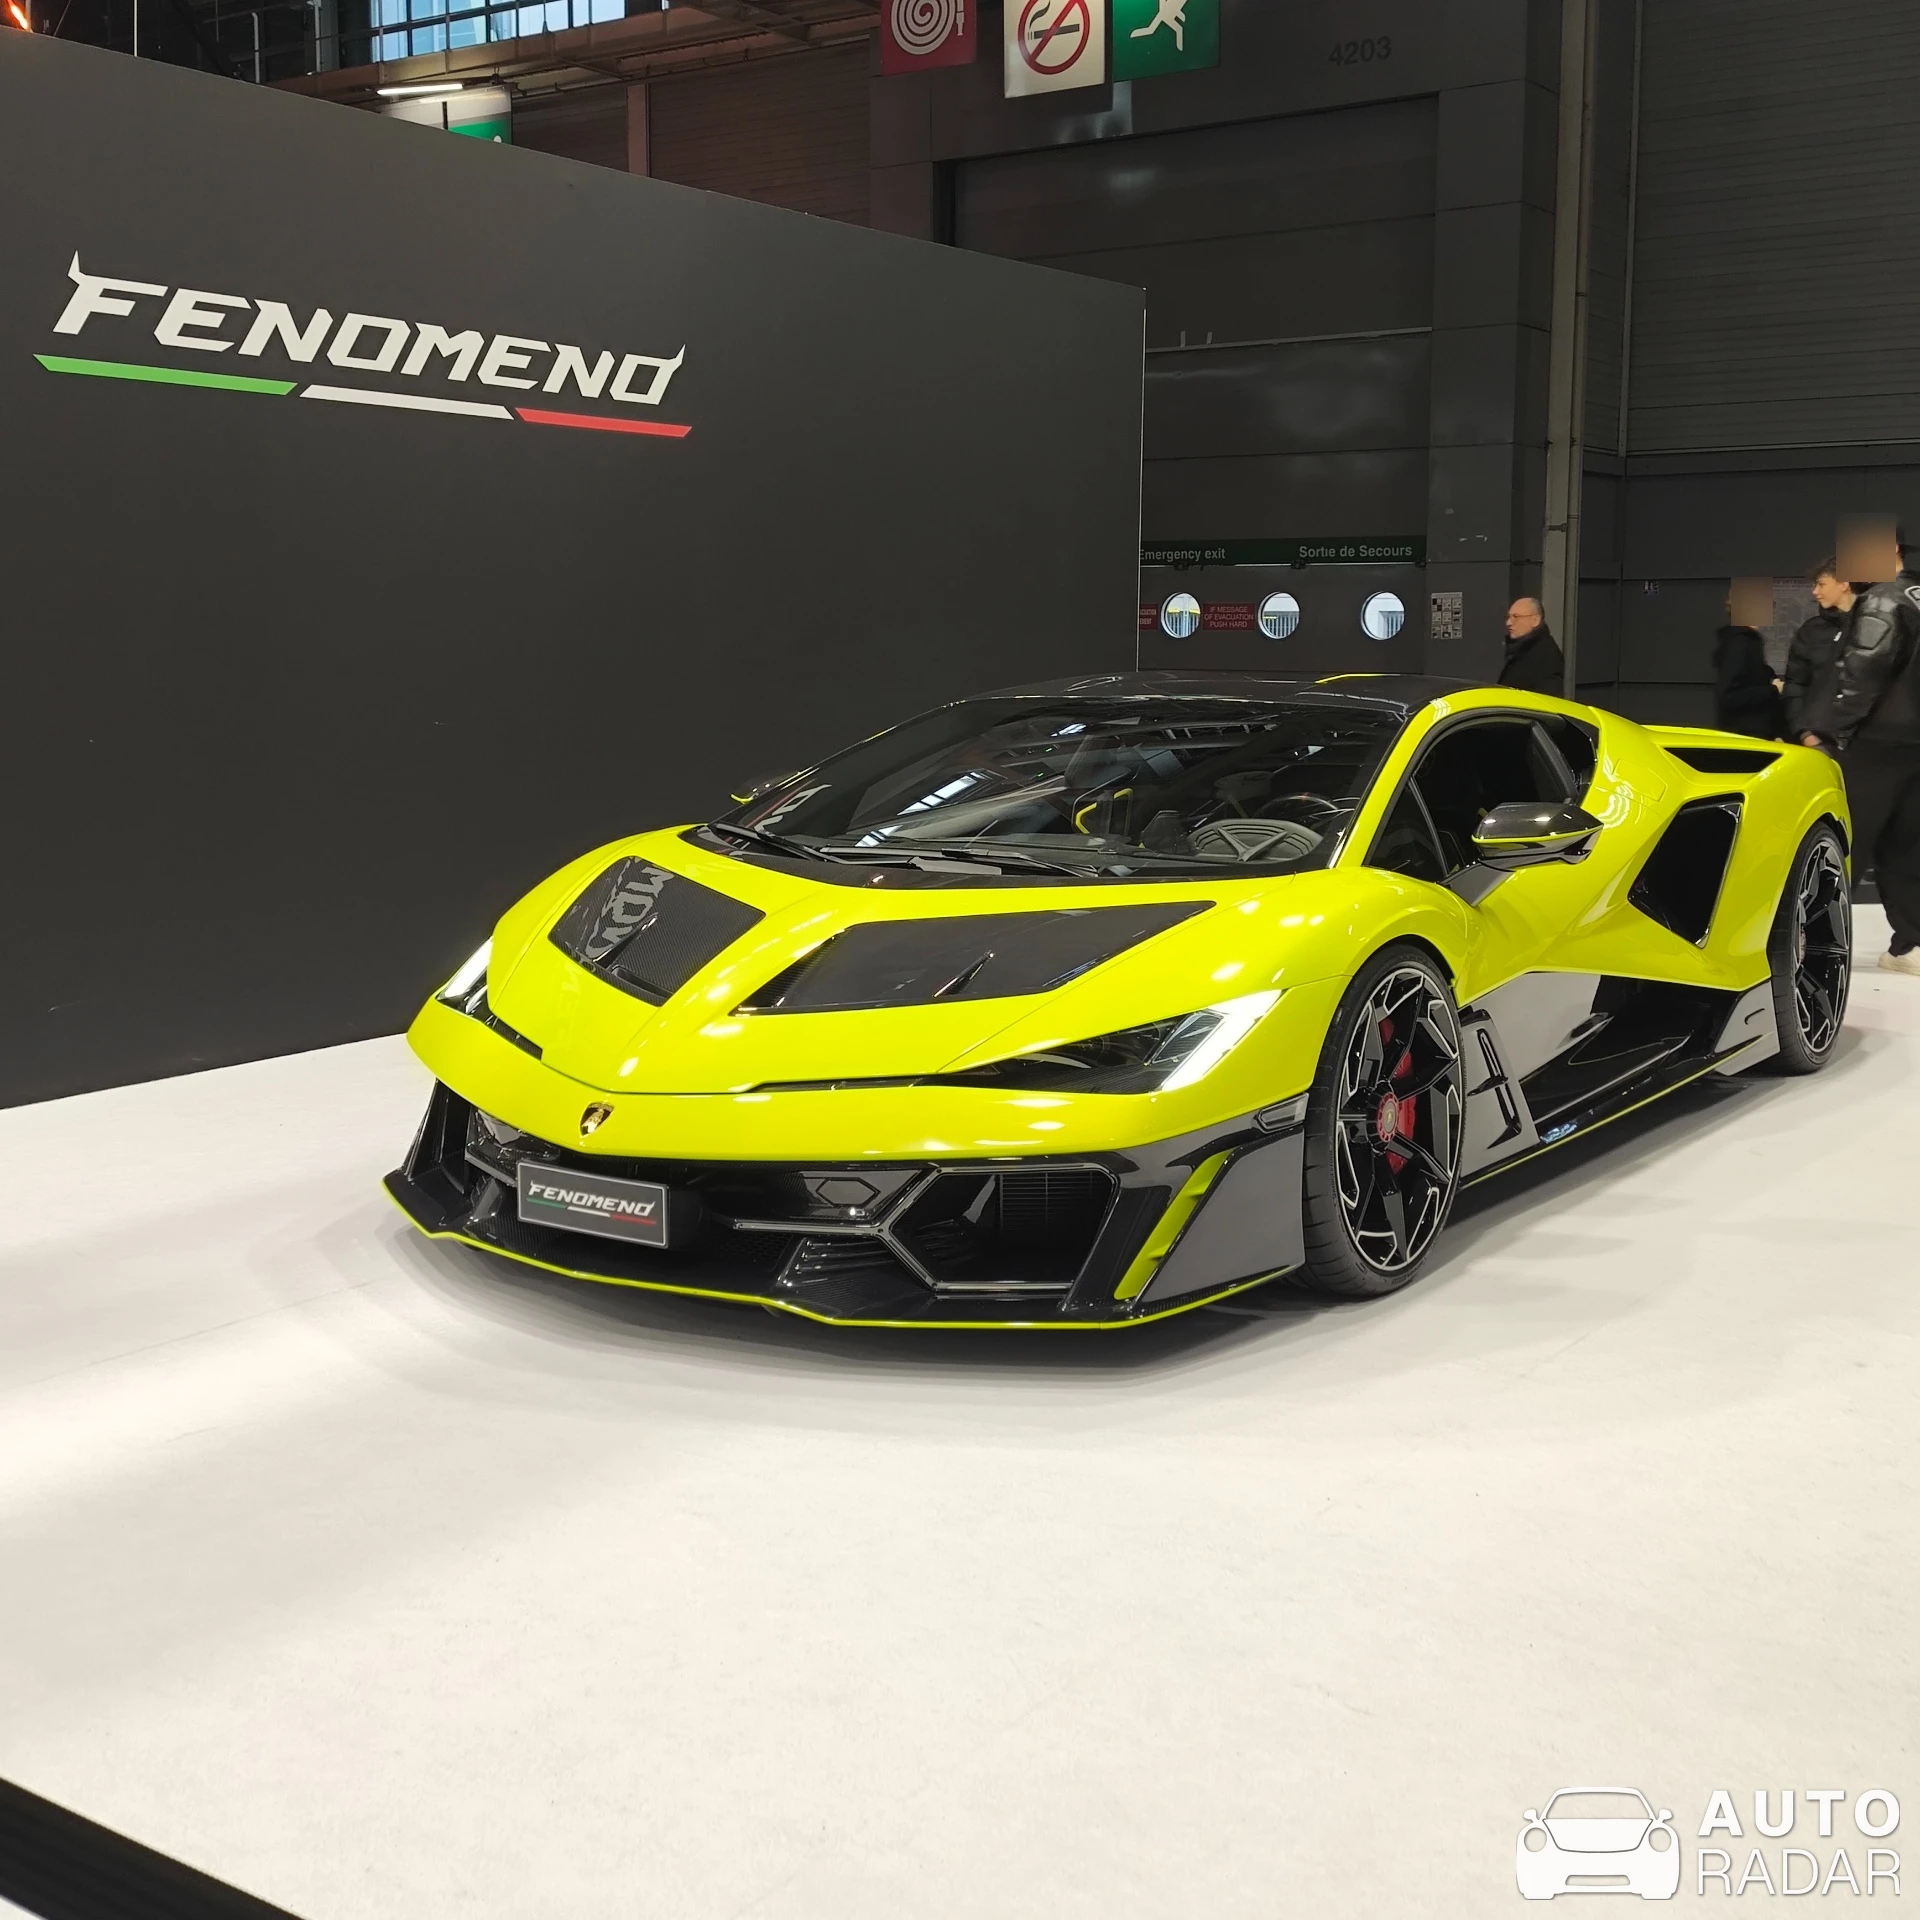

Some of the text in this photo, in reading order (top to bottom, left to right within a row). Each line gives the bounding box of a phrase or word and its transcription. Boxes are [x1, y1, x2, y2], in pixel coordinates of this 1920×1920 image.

[1328, 35, 1392, 66] 4203
[52, 250, 686, 405] FENOMENO
[1204, 547, 1226, 559] exit
[1299, 544, 1412, 557] Sortie de Secours
[1214, 613, 1254, 621] EVACUATION
[528, 1180, 655, 1217] FENOMENO
